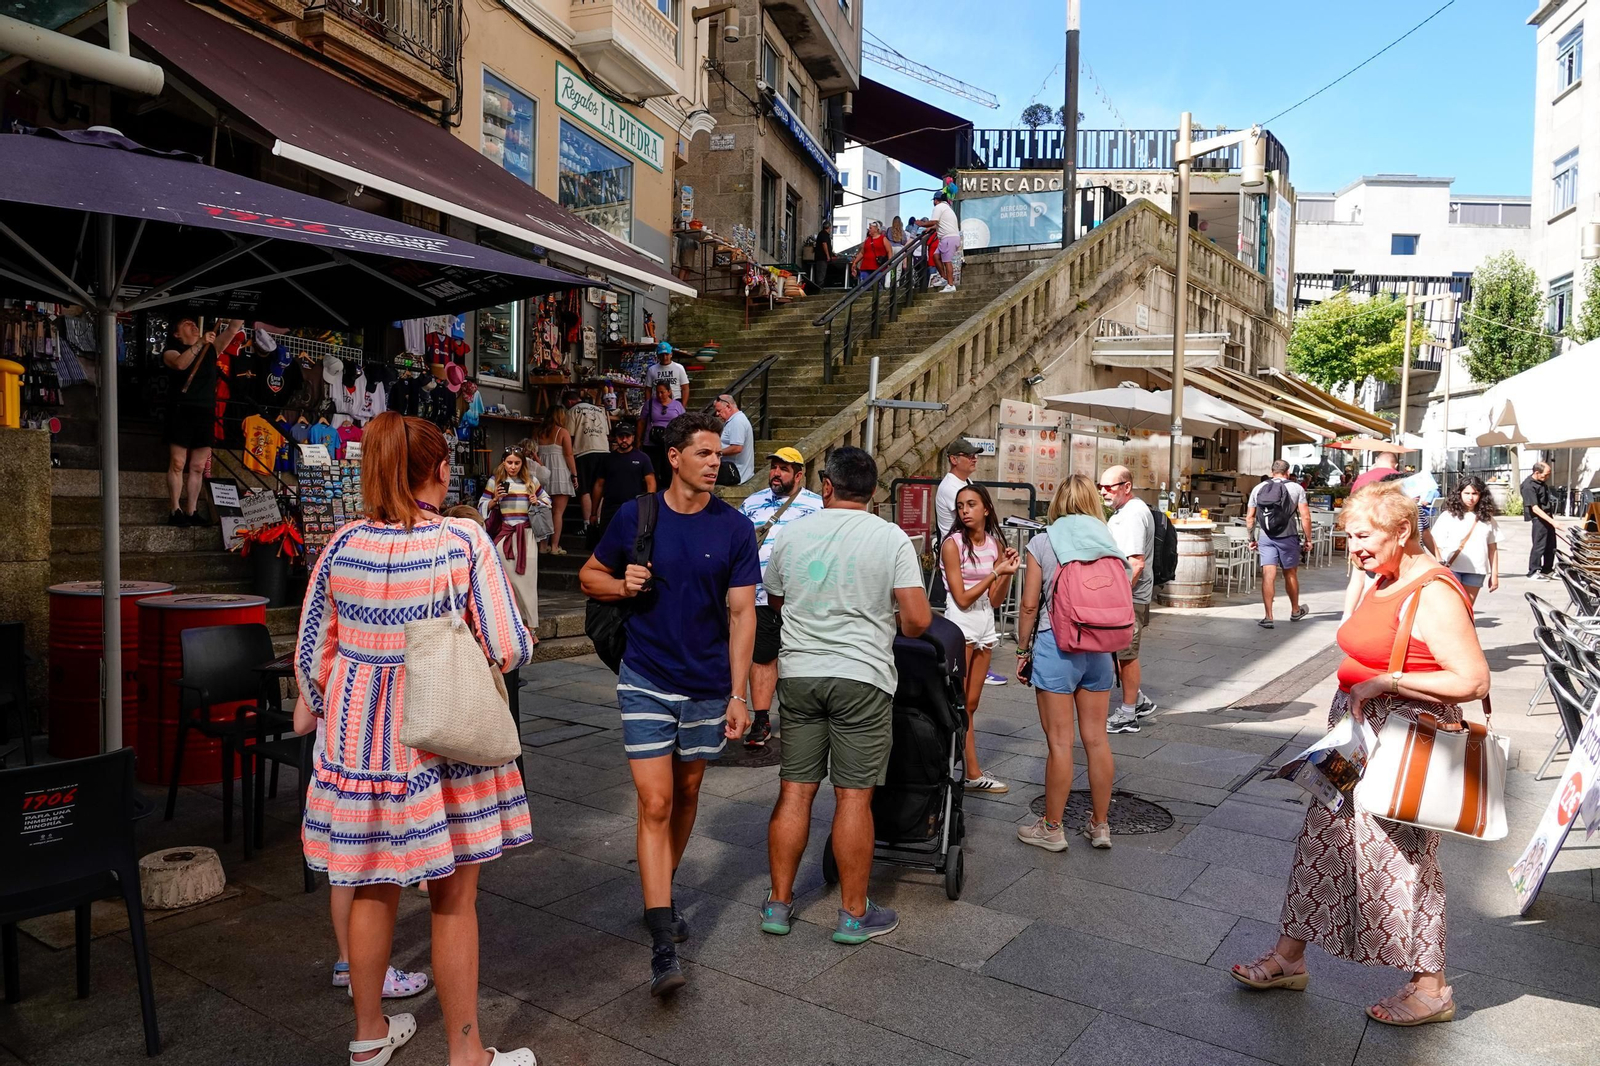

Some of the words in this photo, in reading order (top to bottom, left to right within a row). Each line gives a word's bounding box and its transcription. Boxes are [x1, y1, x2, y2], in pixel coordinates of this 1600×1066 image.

[562, 76, 598, 116] Regalos
[600, 101, 616, 134] LA
[619, 114, 659, 163] PIEDRA
[962, 177, 1063, 192] MERCADO
[1103, 178, 1167, 195] PEDRA
[1000, 204, 1028, 212] MERCADO
[657, 370, 674, 378] PALM
[22, 788, 78, 810] 1906
[24, 812, 51, 821] PARA
[52, 808, 72, 816] UNA
[24, 815, 65, 826] INMENSA
[23, 820, 62, 831] MINORÍA
